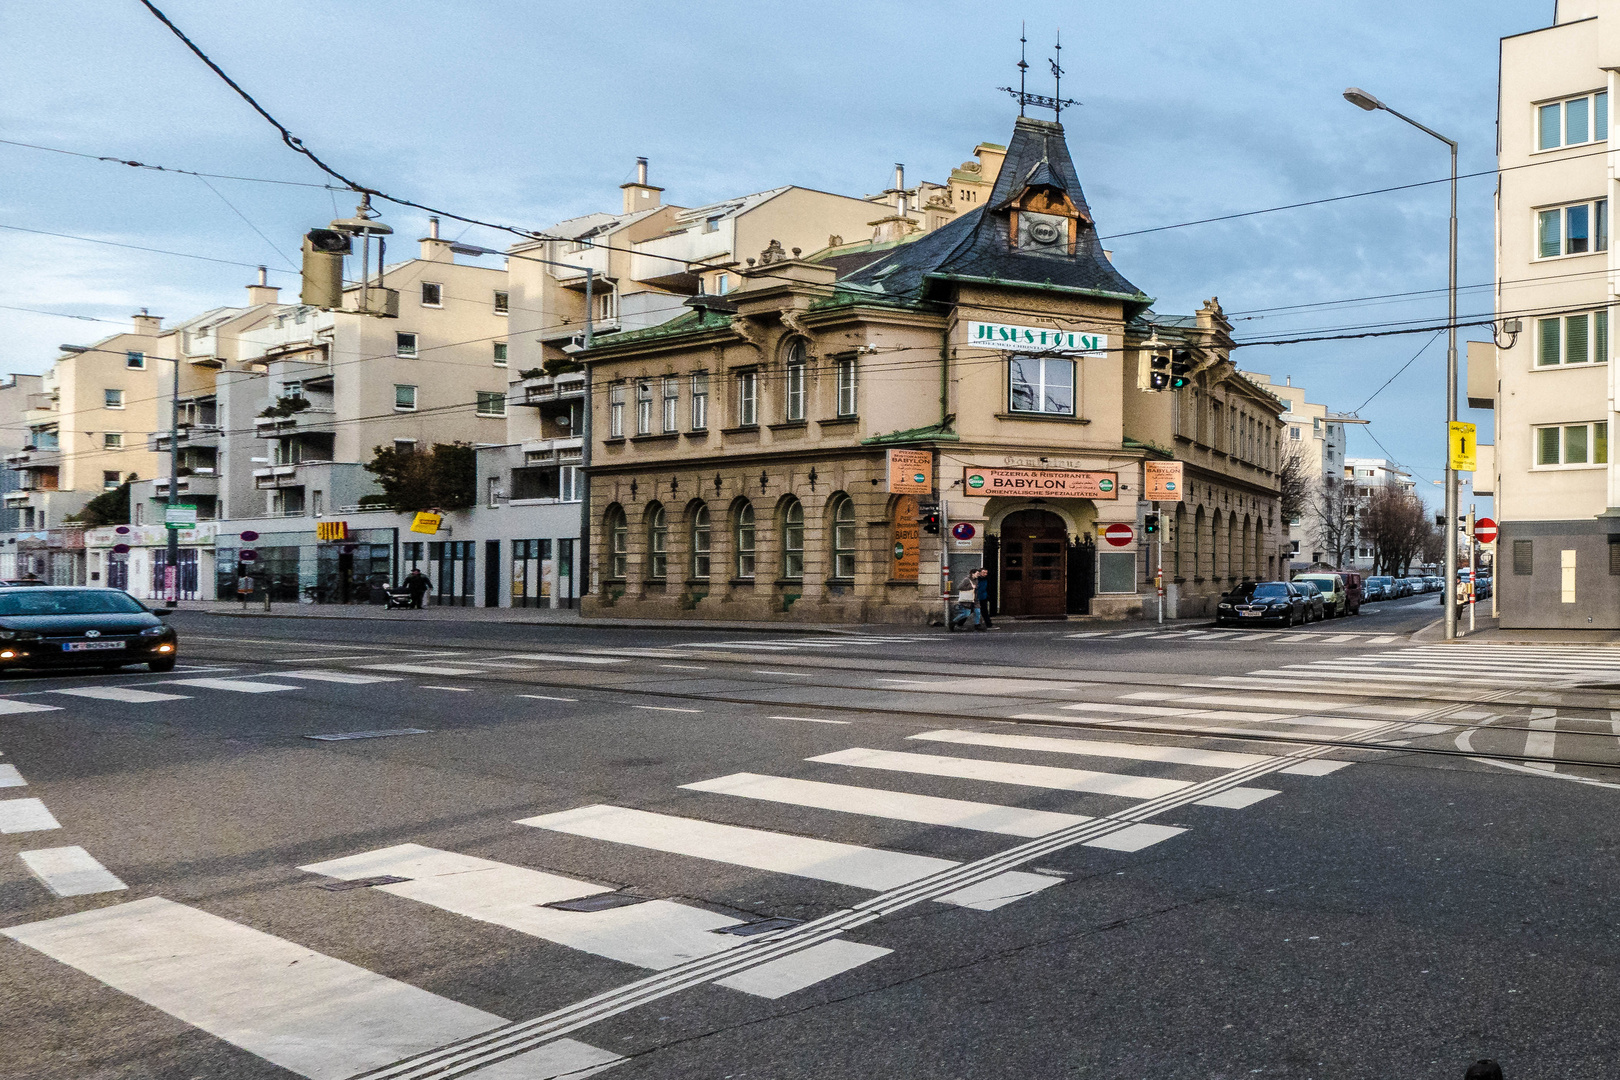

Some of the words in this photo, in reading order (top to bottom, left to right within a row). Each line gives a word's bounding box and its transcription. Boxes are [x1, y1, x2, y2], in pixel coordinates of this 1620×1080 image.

[974, 325, 1034, 344] JESUS
[1041, 329, 1103, 350] HOUSE
[990, 470, 1032, 478] PIZZERIA
[1039, 471, 1091, 479] RISTORANTE
[993, 478, 1066, 489] BABYLON
[985, 488, 1044, 496] ORIENTALISCHE
[317, 521, 346, 540] BILLA
[896, 530, 918, 540] BABYLO
